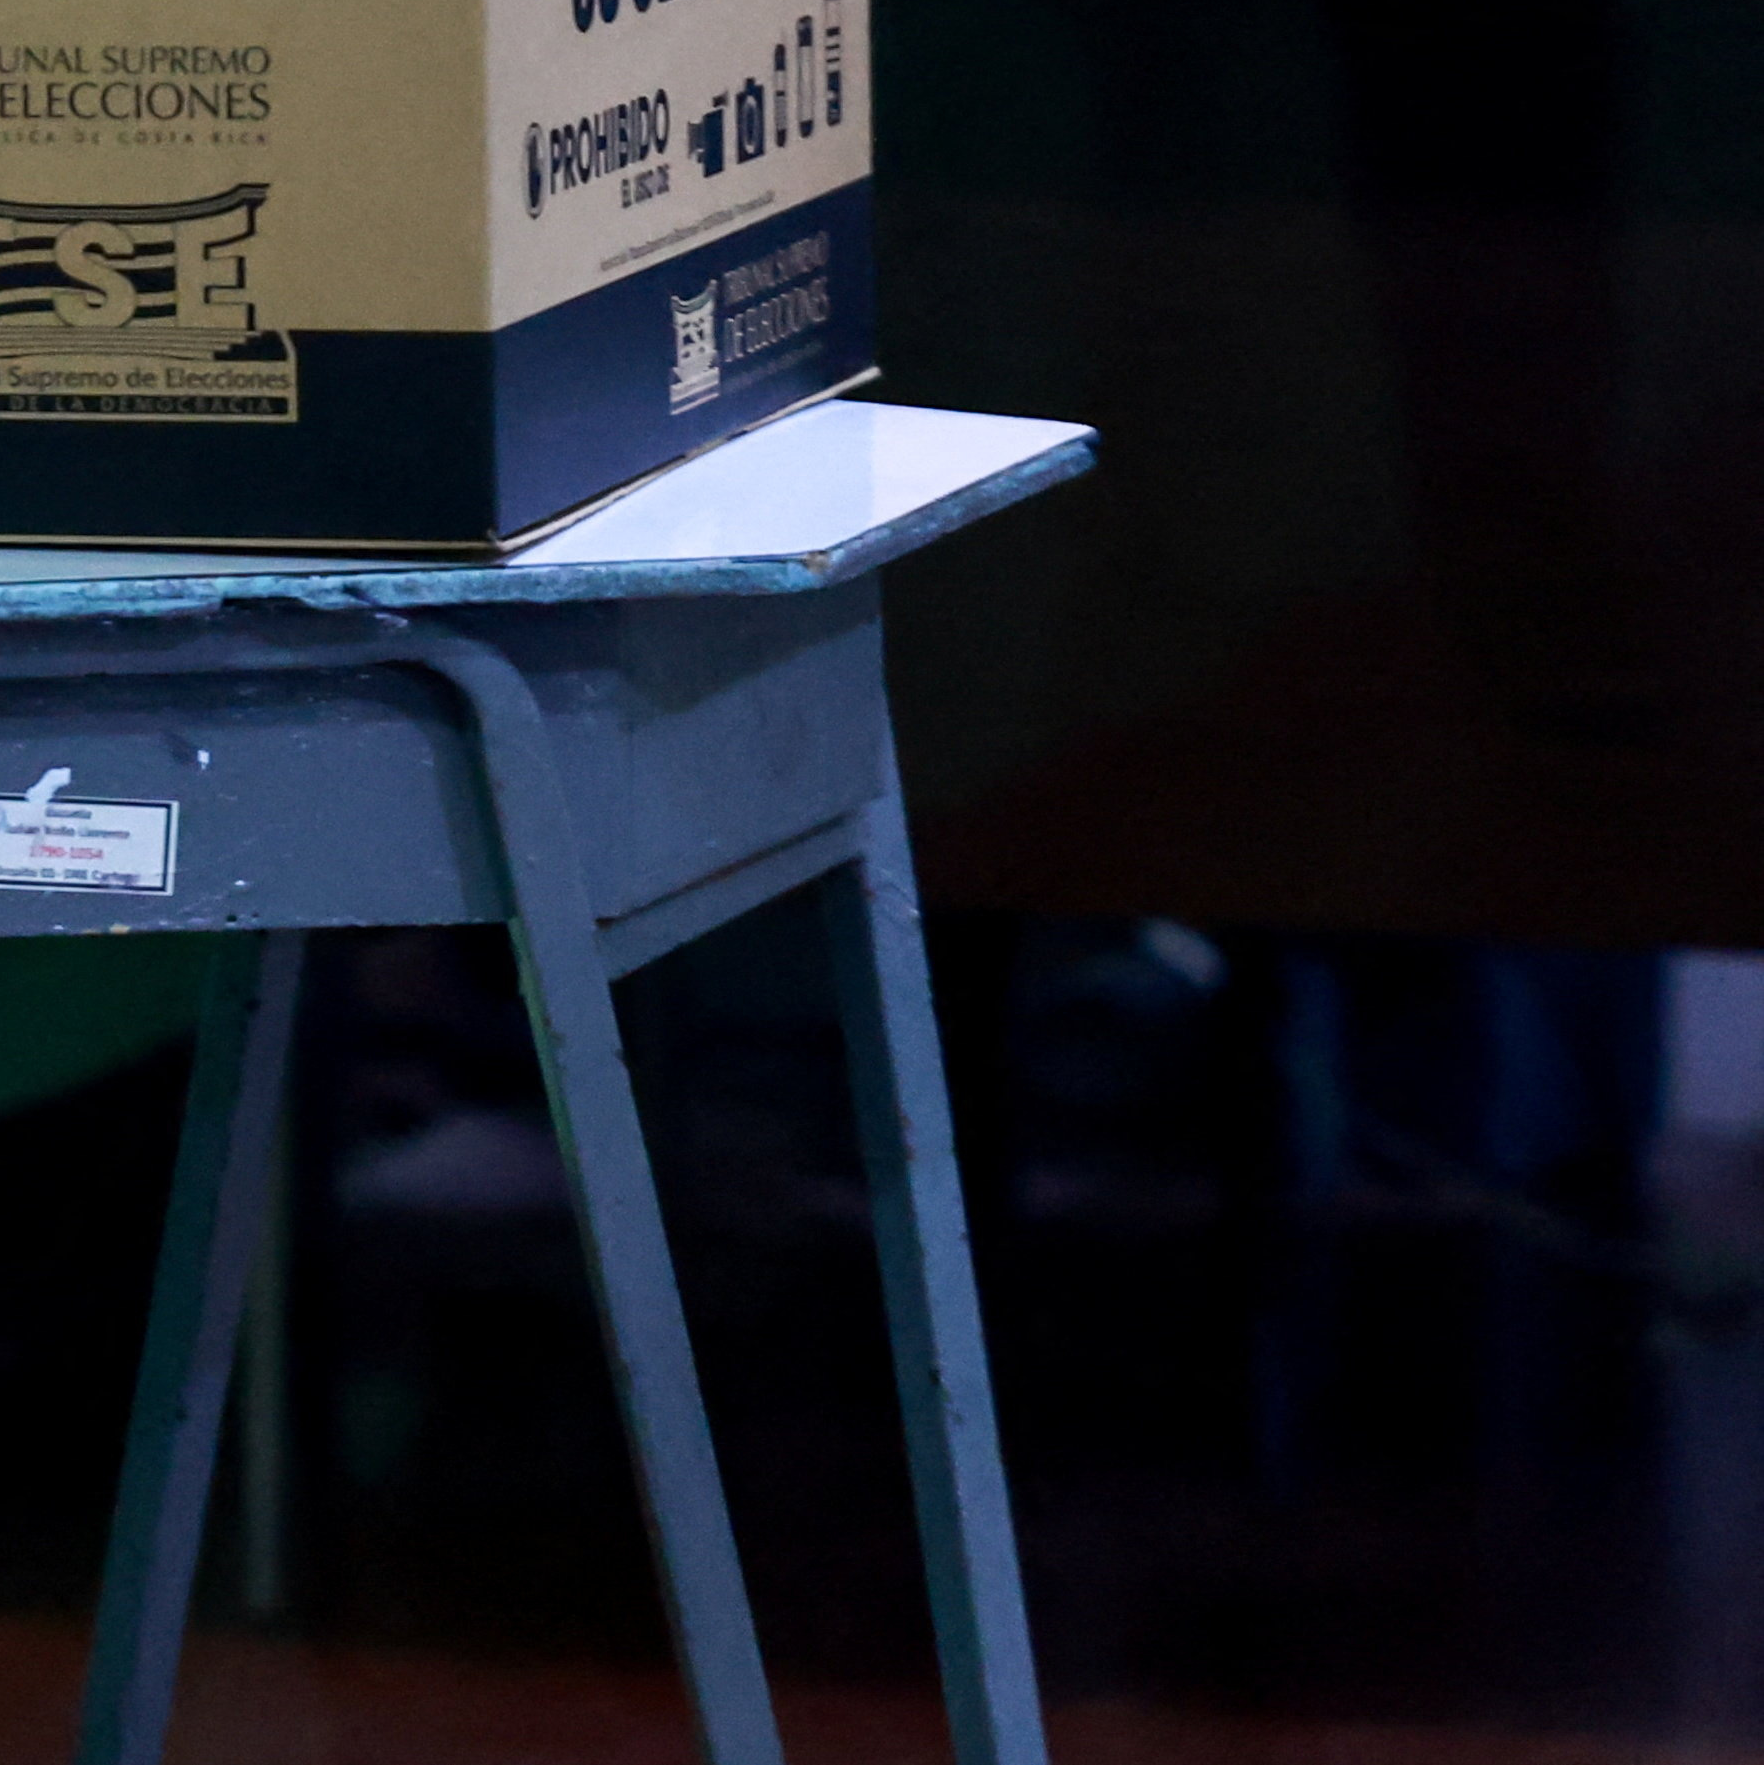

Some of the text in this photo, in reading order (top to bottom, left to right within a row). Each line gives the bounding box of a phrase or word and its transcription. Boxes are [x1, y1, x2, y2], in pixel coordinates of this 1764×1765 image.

[100, 44, 271, 75] SUPREMO
[549, 88, 670, 195] PROHIBIDO
[9, 365, 116, 394] Supremo
[124, 366, 156, 389] de
[165, 367, 290, 390] Elecciones
